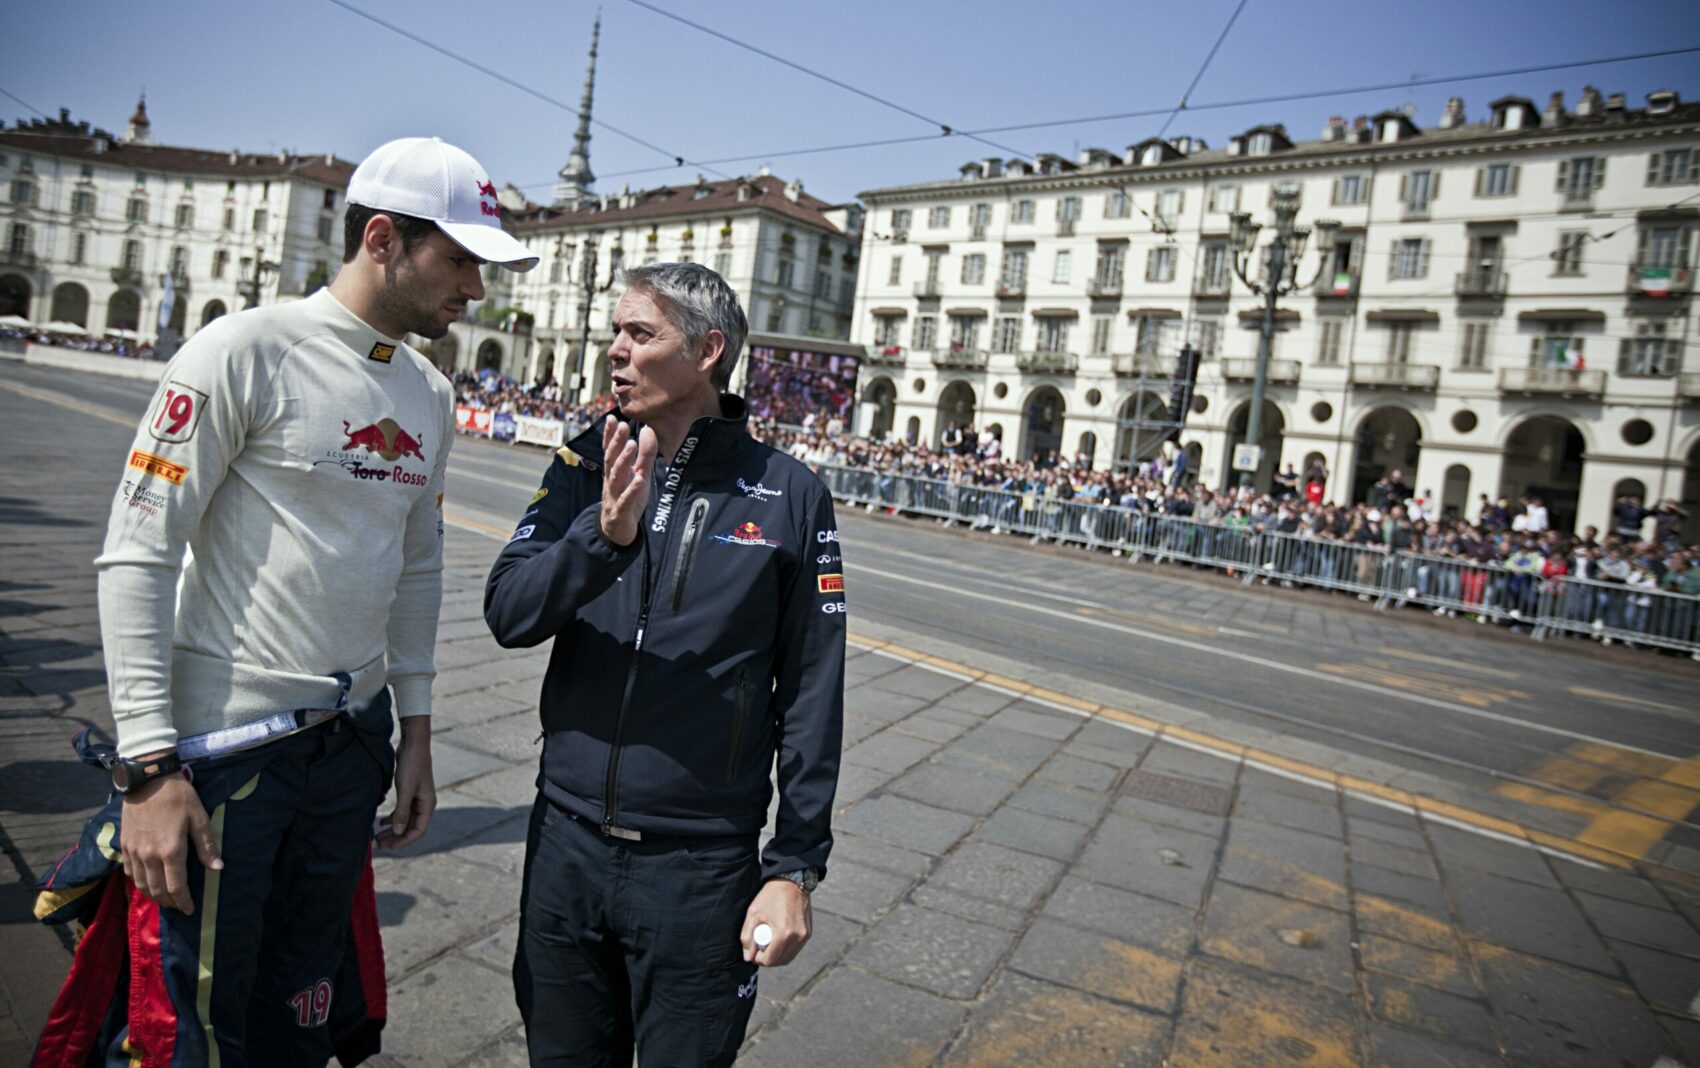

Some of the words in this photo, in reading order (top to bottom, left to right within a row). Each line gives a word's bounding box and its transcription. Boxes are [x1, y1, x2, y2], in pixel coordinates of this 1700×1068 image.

[154, 389, 194, 436] 19
[326, 450, 370, 461] SCUDERIA
[674, 437, 700, 465] GIVES
[130, 451, 186, 483] PIRELLI
[352, 461, 387, 481] Toro
[392, 465, 428, 487] Rosso
[664, 466, 685, 491] YOU
[131, 493, 166, 510] Service
[134, 485, 167, 502] Money
[128, 498, 158, 516] Group
[651, 493, 675, 533] WINGS
[288, 979, 332, 1026] 19
